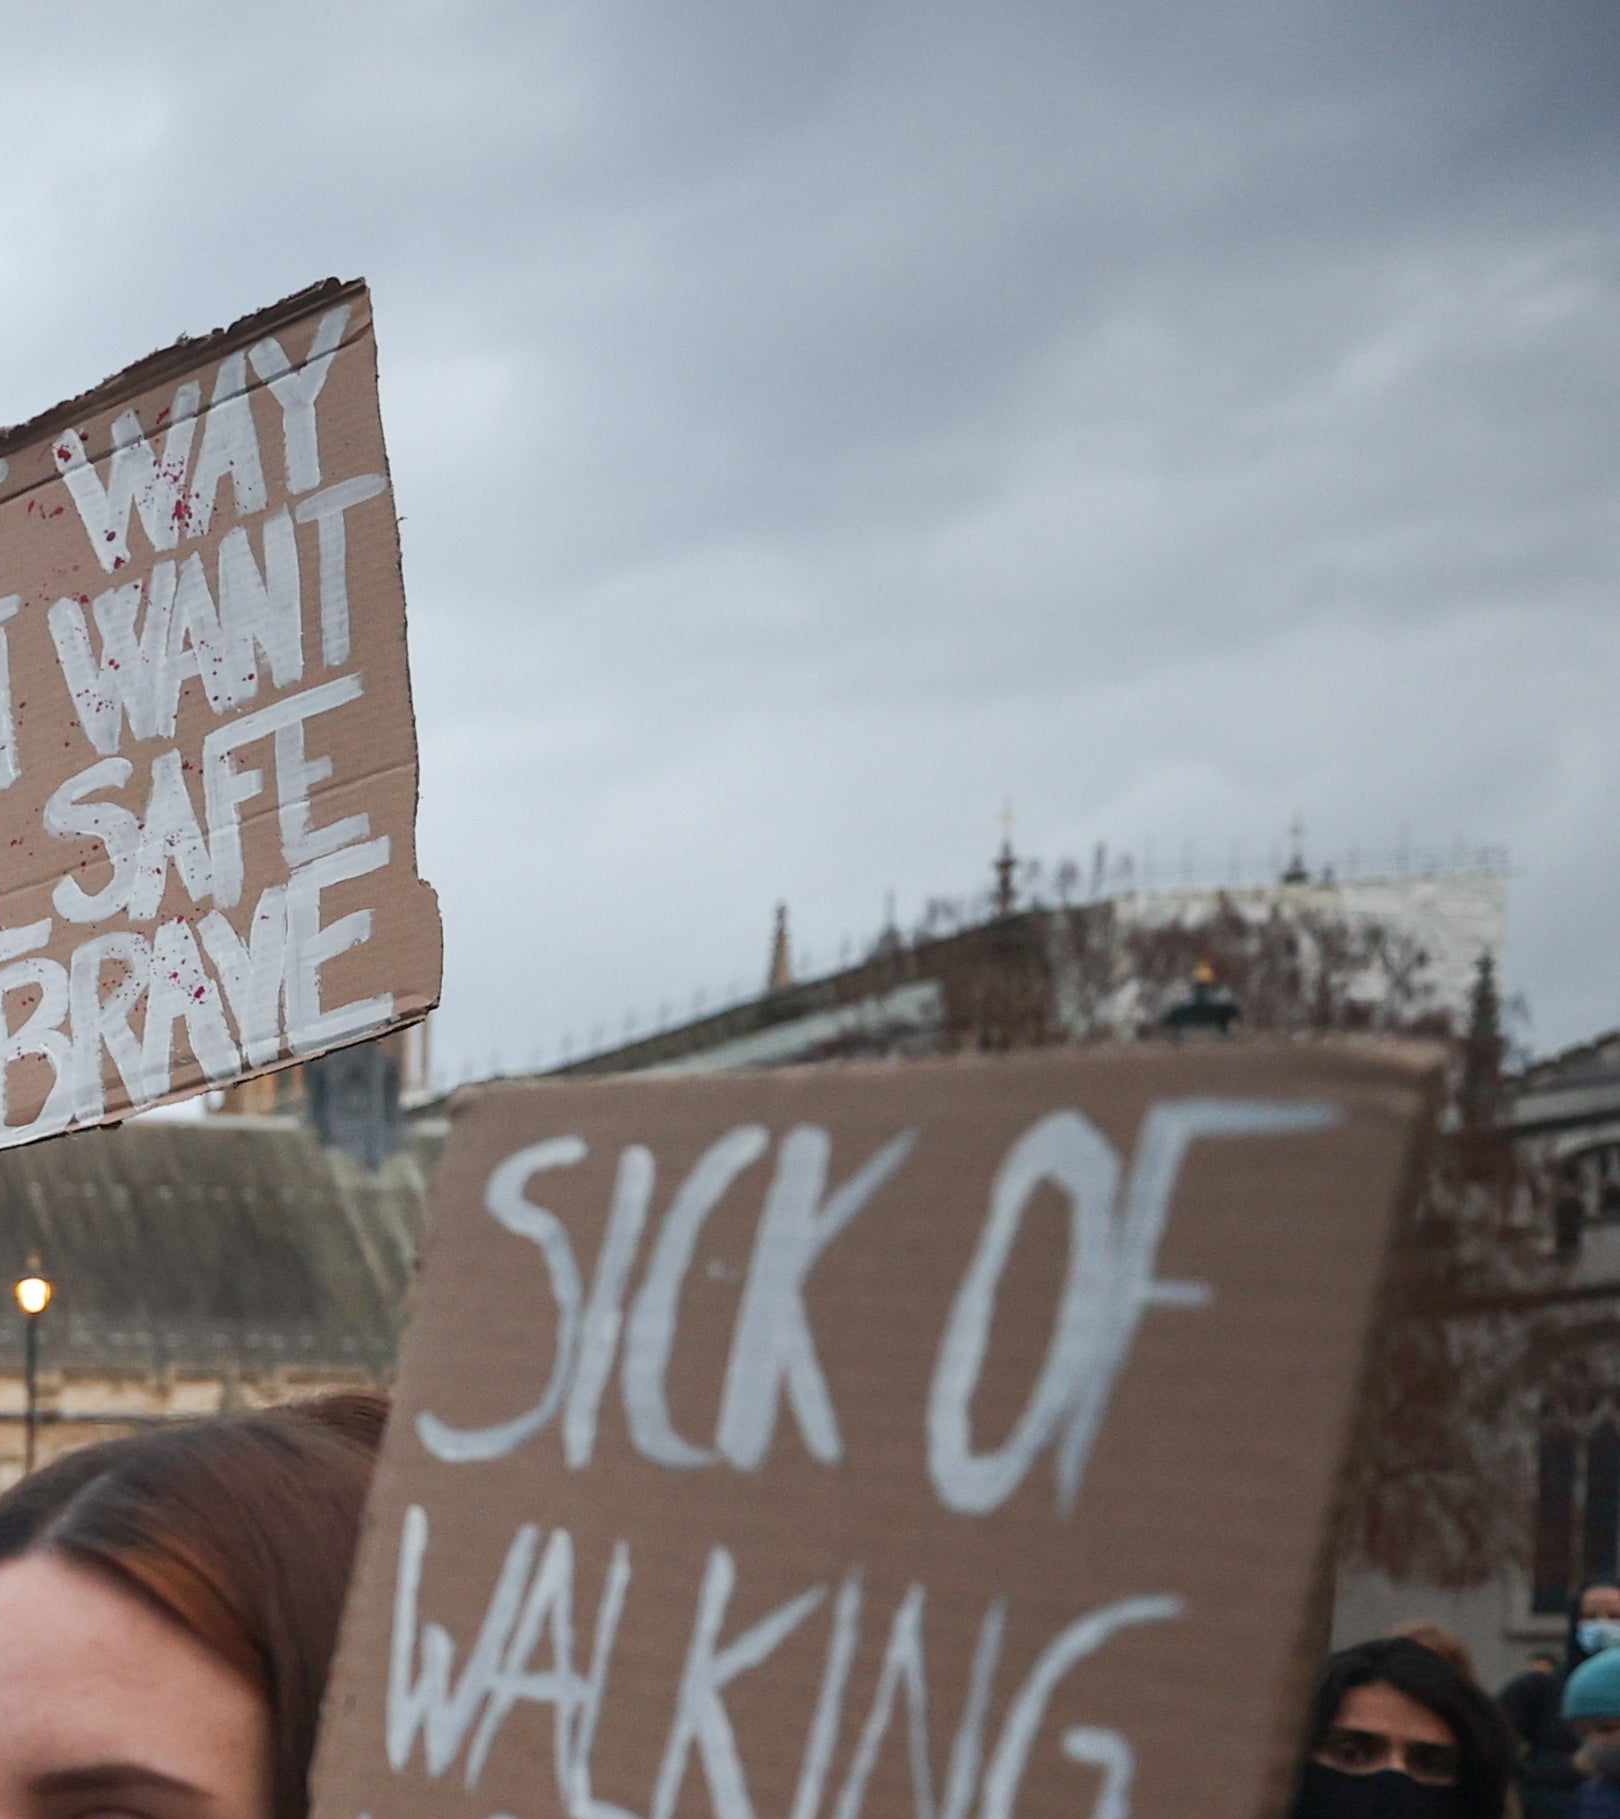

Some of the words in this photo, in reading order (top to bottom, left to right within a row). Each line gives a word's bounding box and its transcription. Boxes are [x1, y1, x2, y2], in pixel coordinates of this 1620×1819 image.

[53, 304, 351, 573] WAY
[48, 474, 388, 755] WANT
[43, 673, 370, 923] SAFE
[416, 1123, 919, 1473] SICK
[926, 1098, 1342, 1516] OF
